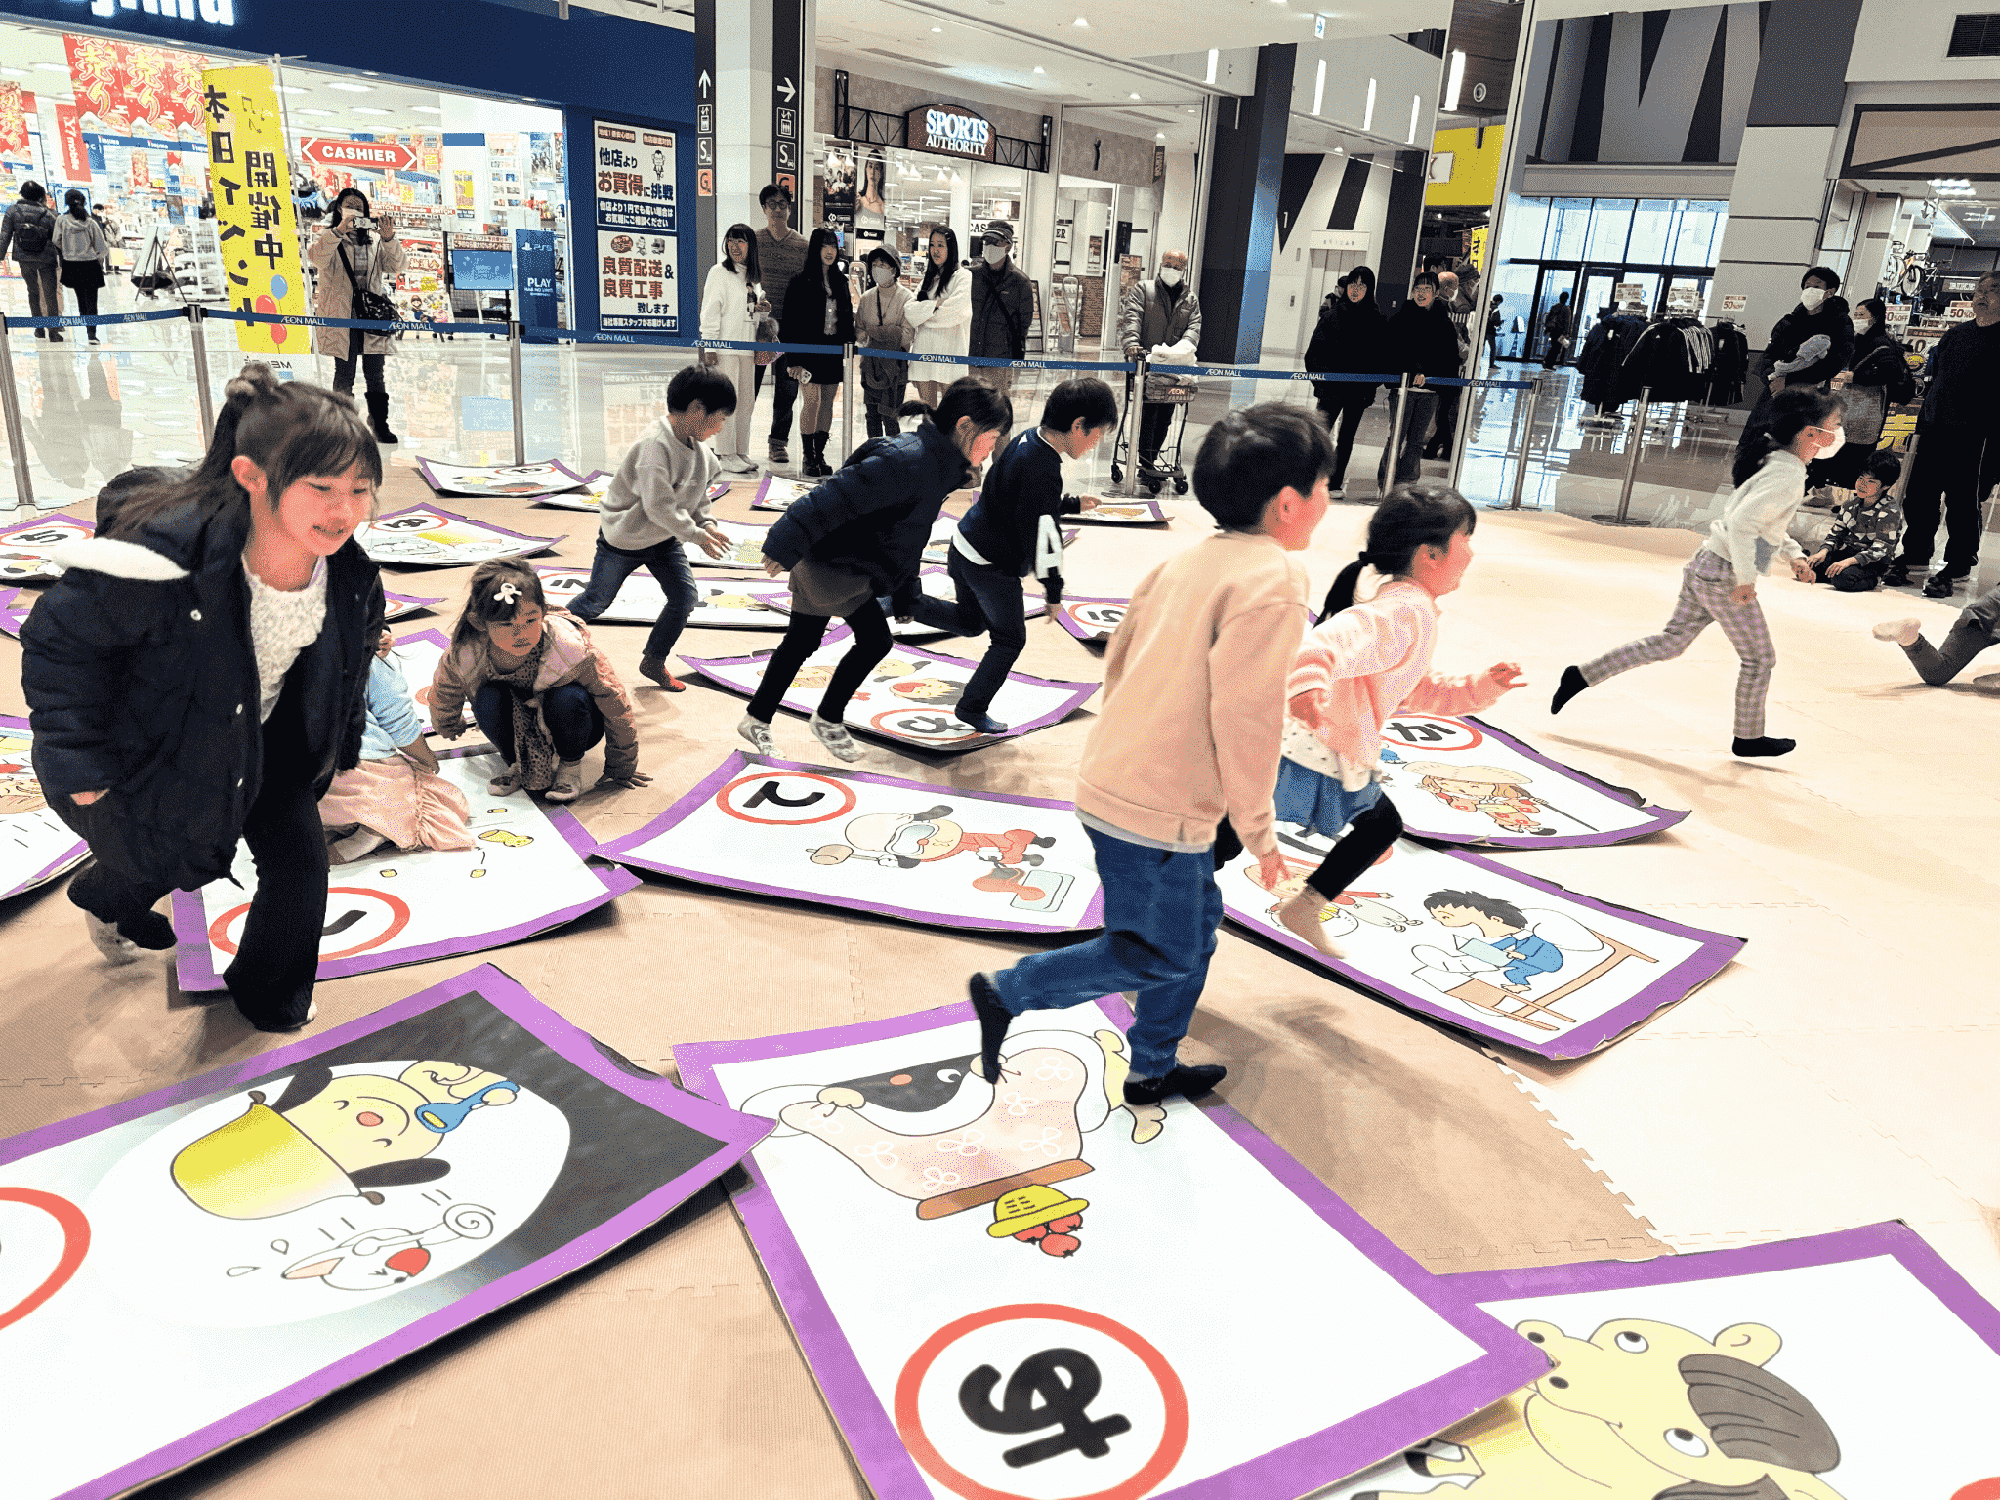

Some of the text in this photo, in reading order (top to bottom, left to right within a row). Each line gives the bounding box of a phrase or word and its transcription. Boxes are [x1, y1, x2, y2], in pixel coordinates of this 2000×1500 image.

[926, 108, 989, 143] SPORTS
[700, 140, 707, 160] S
[926, 135, 987, 156] AUTHORITY
[322, 145, 397, 163] CASHIER
[599, 147, 638, 168] 他店より
[779, 144, 788, 164] S
[598, 171, 674, 201] お買得に挑戦
[527, 277, 551, 287] PLAY
[603, 278, 663, 300] 良質工事
[637, 302, 669, 314] 致します
[73, 317, 87, 326] MALL
[136, 313, 147, 321] MALL
[304, 317, 327, 326] MALL
[1886, 311, 1908, 323] 0%OFF
[411, 322, 433, 330] MALL
[614, 335, 635, 343] MALL
[713, 340, 733, 349] MALL
[1028, 361, 1047, 369] MALL
[1224, 369, 1242, 377] MALL
[1309, 373, 1326, 381] MALL
[1035, 514, 1063, 579] A
[1386, 722, 1457, 741] か
[742, 780, 826, 808] て
[958, 1348, 1132, 1468] あ
